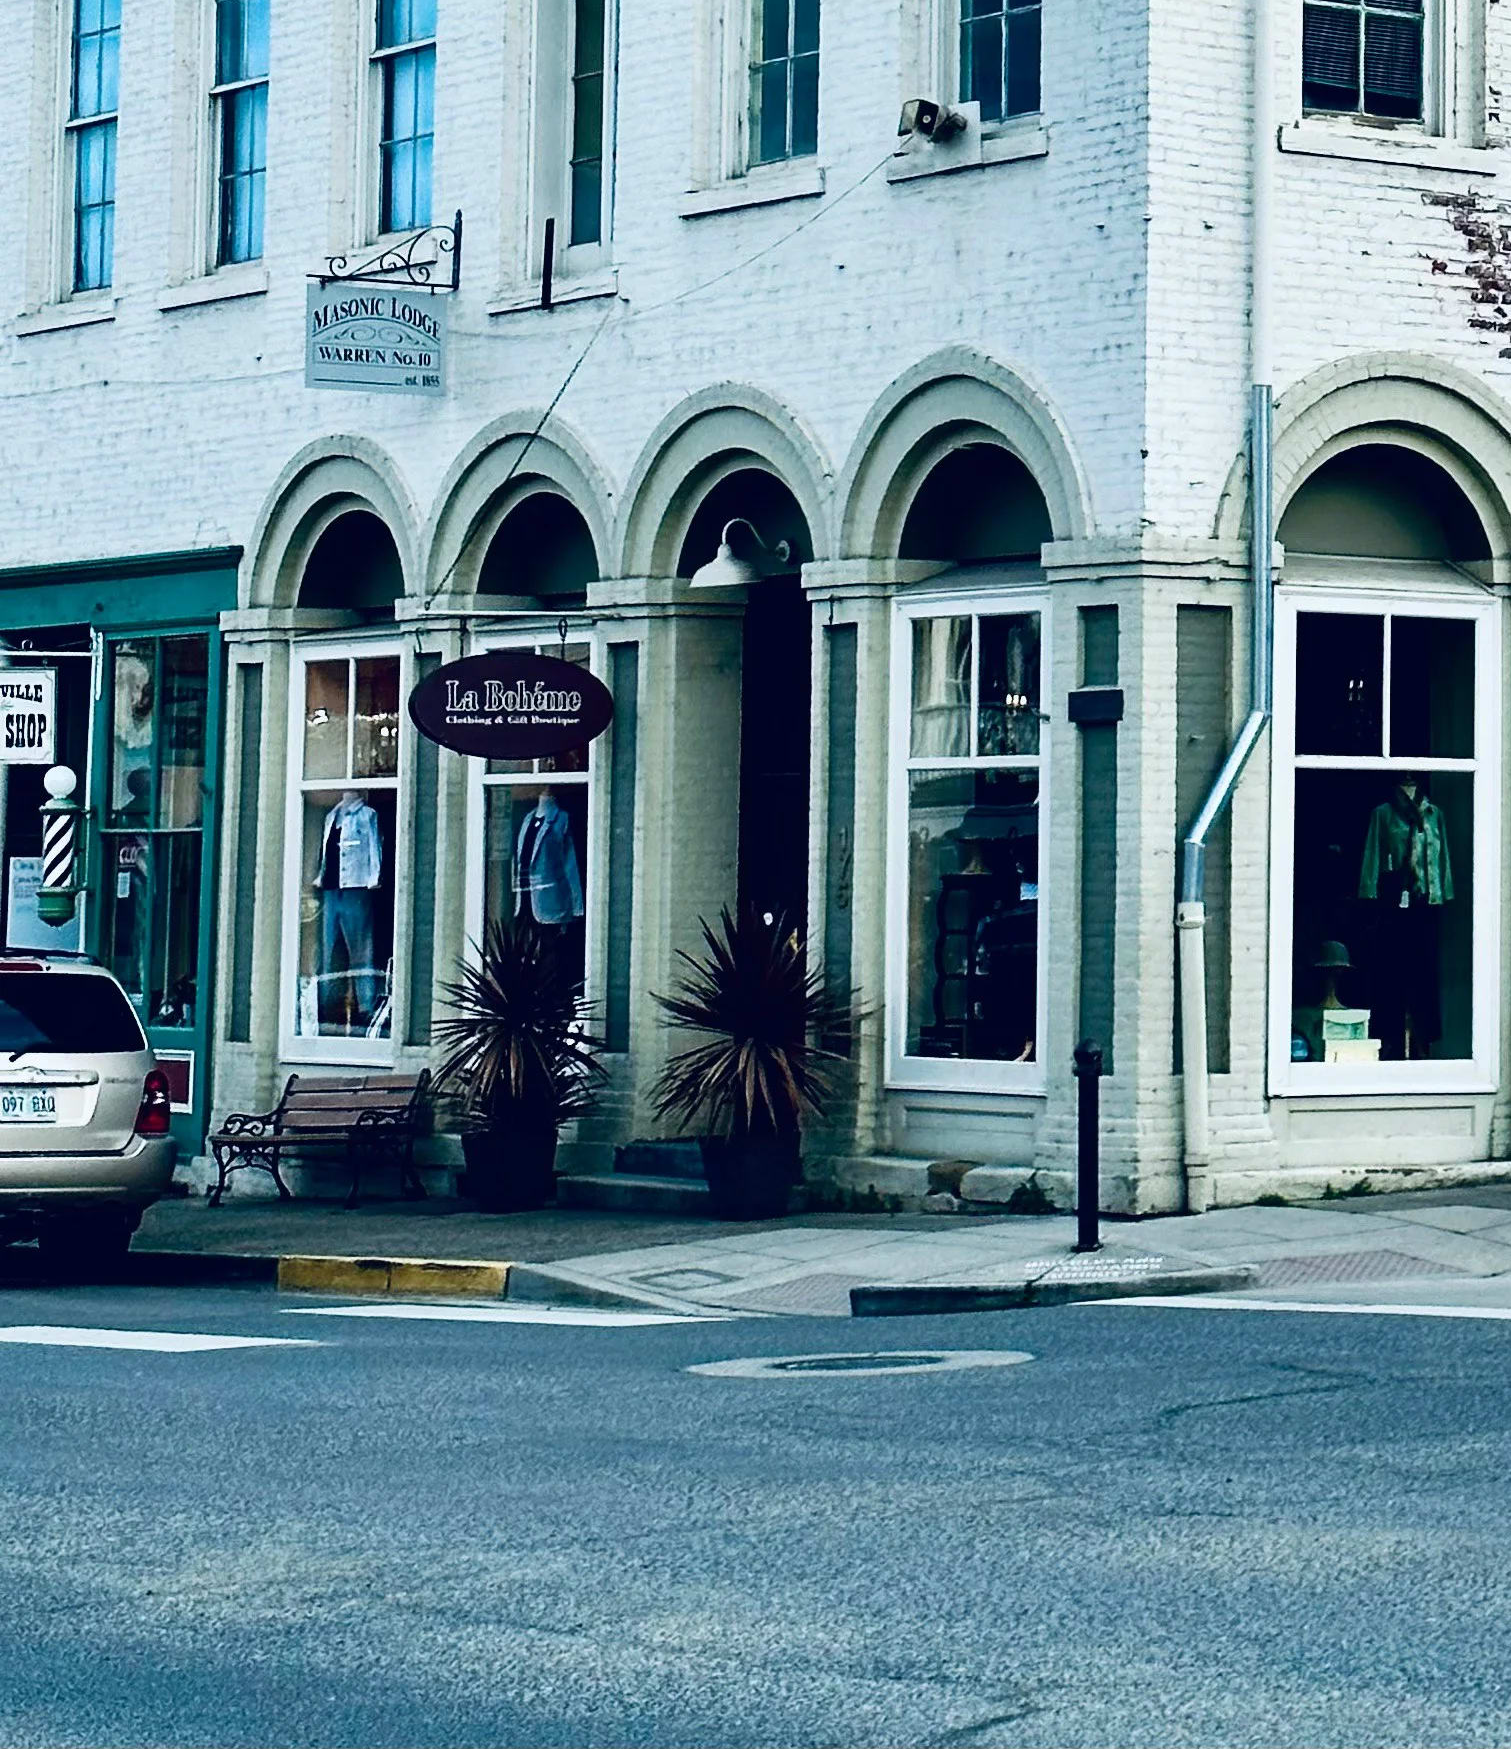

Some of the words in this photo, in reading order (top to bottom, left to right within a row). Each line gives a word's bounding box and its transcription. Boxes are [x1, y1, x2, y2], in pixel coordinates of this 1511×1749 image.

[313, 297, 386, 333] MASONIC
[391, 296, 441, 340] LODGE
[319, 346, 386, 364] WARREN
[418, 353, 431, 367] 10
[445, 680, 480, 712] La
[5, 713, 47, 748] SHOP
[445, 715, 493, 725] Clothing
[495, 716, 503, 724] &
[507, 715, 528, 724] Gift
[531, 715, 580, 727] Boutique
[2, 1096, 25, 1113] 097
